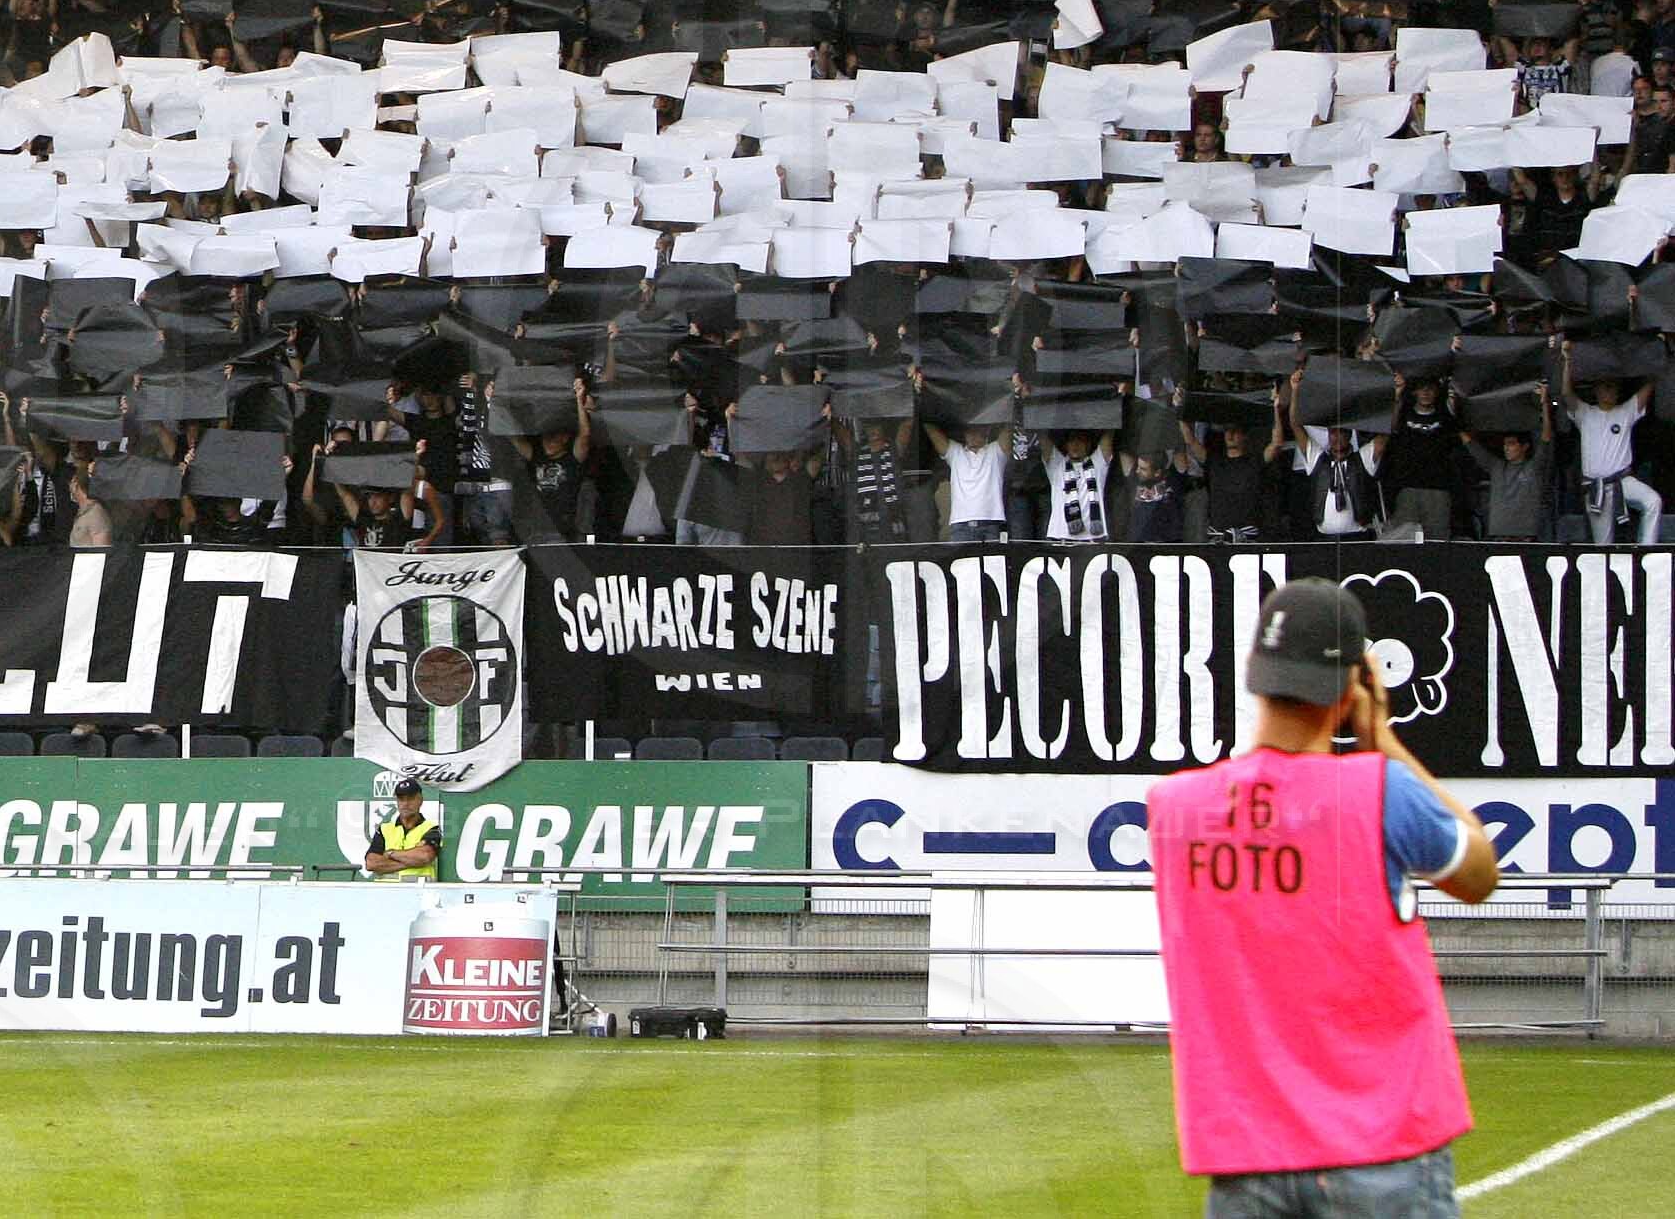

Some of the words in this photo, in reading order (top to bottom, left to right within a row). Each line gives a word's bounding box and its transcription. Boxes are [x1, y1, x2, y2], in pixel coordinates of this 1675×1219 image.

[385, 560, 497, 593] Junge
[553, 573, 735, 656] SCHWARZE
[749, 571, 838, 656] SZENE
[654, 672, 763, 692] WIEN
[1187, 842, 1304, 895] FOTO
[410, 944, 544, 988] KLEINE
[406, 997, 542, 1024] ZEITUNG
